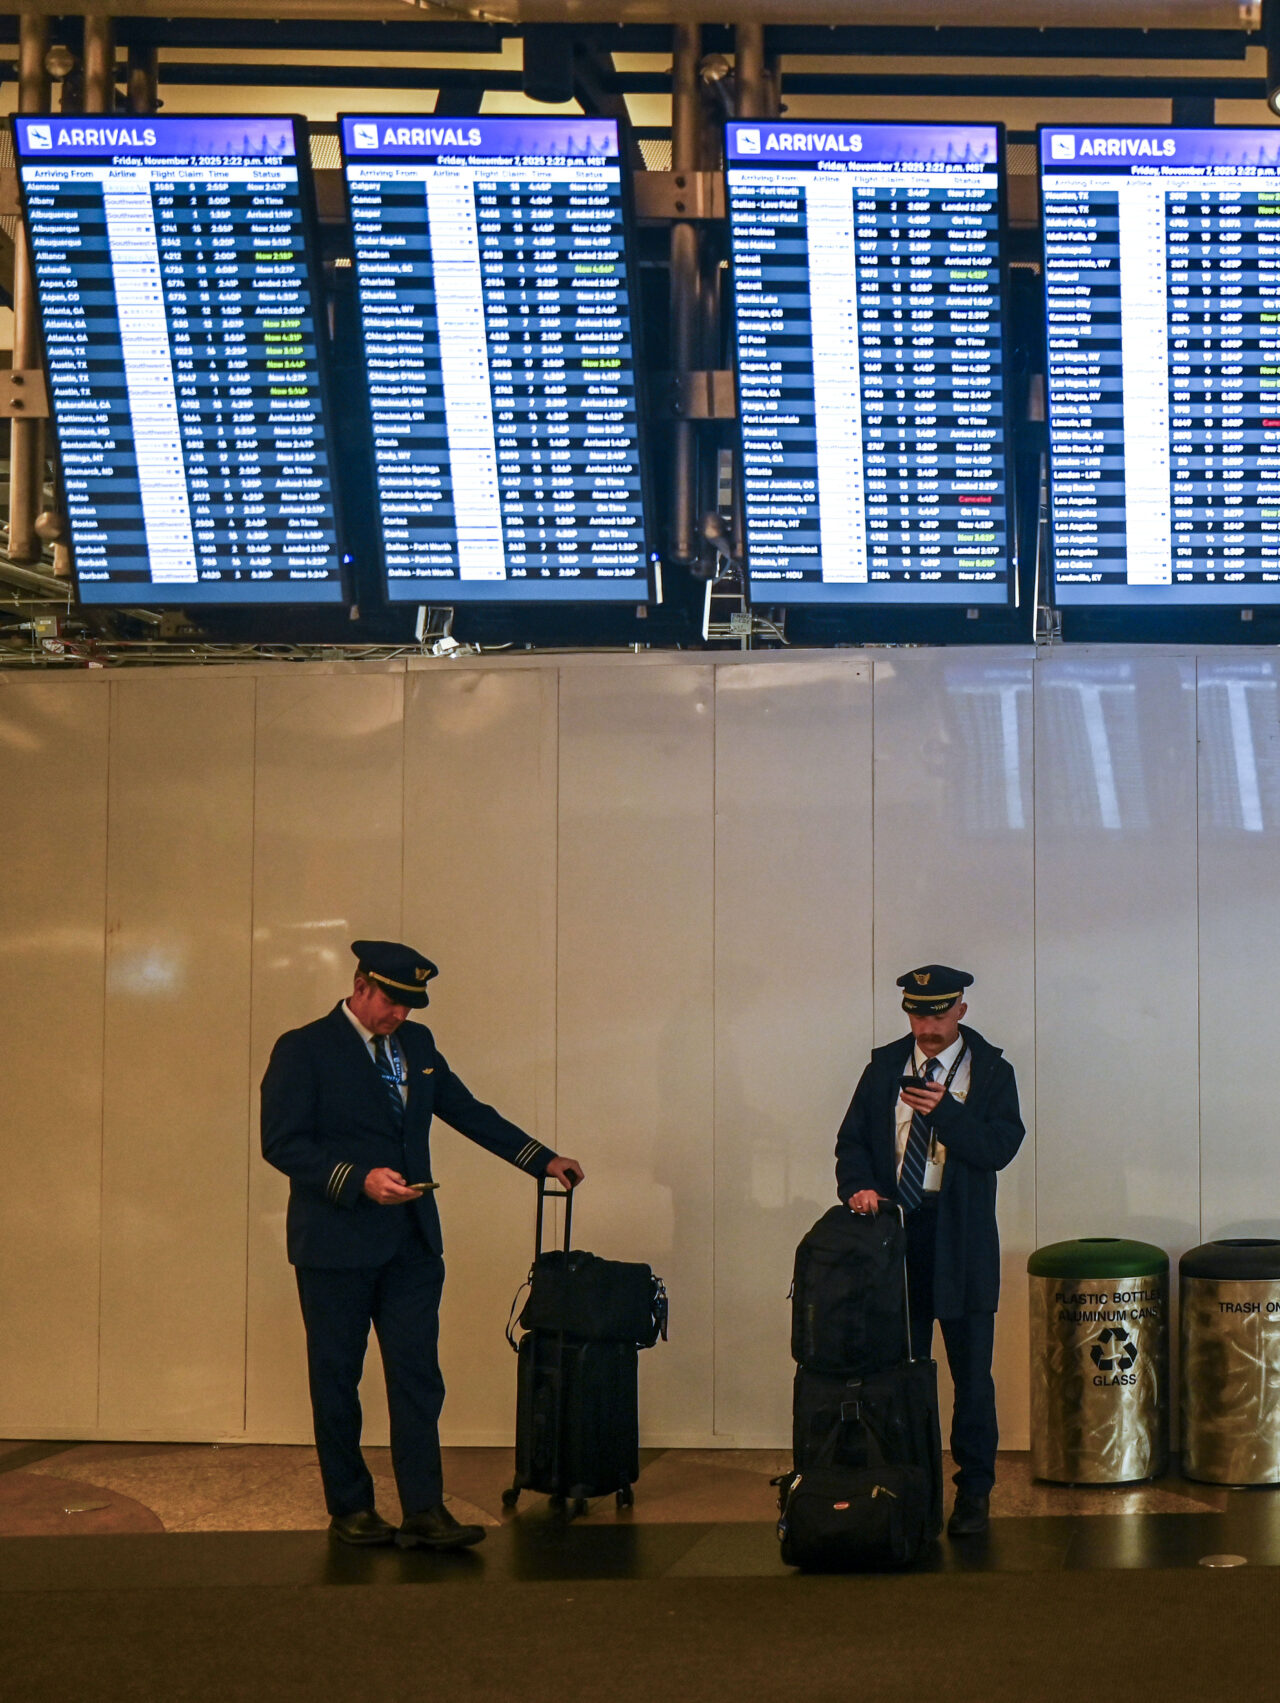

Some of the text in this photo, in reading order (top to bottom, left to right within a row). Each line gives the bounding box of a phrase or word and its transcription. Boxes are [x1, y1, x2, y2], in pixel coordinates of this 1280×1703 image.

[55, 128, 157, 146] ARRIVALS
[381, 127, 482, 146] ARRIVALS
[764, 132, 863, 152] ARRIVALS
[1079, 137, 1176, 156] ARRIVALS
[111, 156, 283, 167] Friday, November 7, 2025 2:22 p.m. MST
[467, 156, 513, 165] November
[522, 156, 545, 165] 2025
[566, 157, 586, 167] p.m.
[586, 156, 606, 166] MST
[848, 161, 892, 171] November
[901, 162, 924, 171] 2025
[945, 164, 965, 173] p.m.
[965, 163, 984, 172] MST
[33, 169, 93, 178] Arriving From
[107, 169, 136, 177] Airline
[150, 169, 175, 179] Flight
[178, 169, 203, 177] Claim
[208, 169, 229, 177] Time
[358, 168, 418, 178] Arriving From
[432, 169, 460, 177] Airline
[474, 169, 498, 178] Flight
[501, 169, 526, 177] Claim
[531, 169, 552, 177] Time
[575, 170, 603, 178] Status
[26, 182, 59, 190] Alamosa
[27, 197, 55, 206] Albany
[104, 197, 145, 206] Southwest
[29, 211, 78, 220] Albuquerque
[35, 252, 66, 260] Alliance
[37, 266, 71, 274] Asheville
[39, 280, 78, 289] Aspen, CO
[42, 307, 84, 316] Atlanta, GA
[48, 348, 74, 356] Austin,
[55, 401, 111, 410] Bakersfield, CA
[57, 415, 95, 423] Baltimore,
[64, 467, 113, 476] Bismarck, ND
[69, 506, 96, 514] Boston
[1055, 1293, 1108, 1304] PLASTIC
[1219, 1302, 1260, 1313] TRASH
[1059, 1306, 1158, 1322] ALUMINUM CANS
[1093, 1374, 1137, 1386] GLASS
